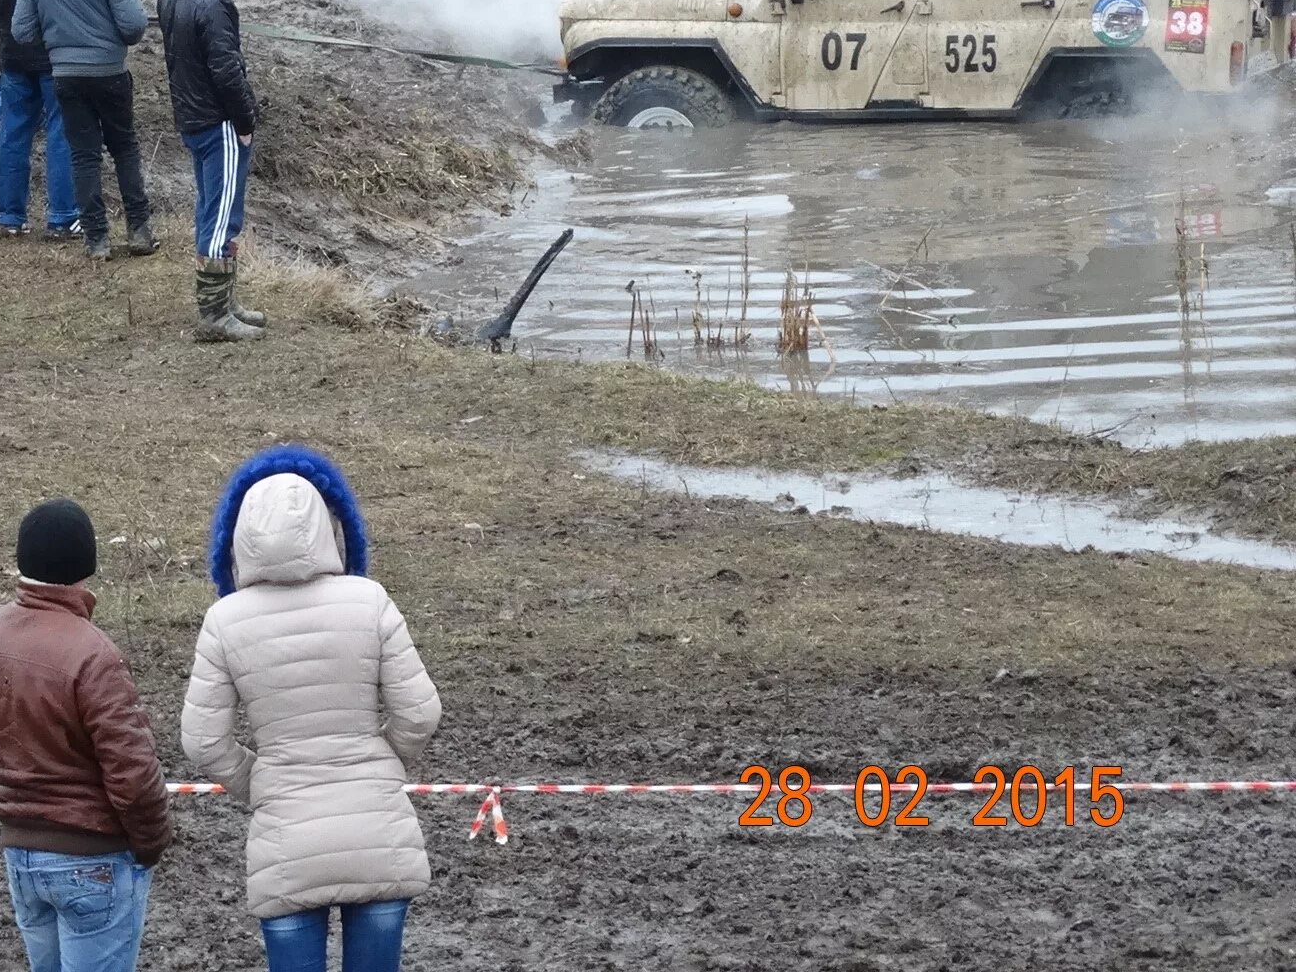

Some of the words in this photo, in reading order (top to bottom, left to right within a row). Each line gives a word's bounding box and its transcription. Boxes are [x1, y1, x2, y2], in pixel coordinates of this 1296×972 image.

[1170, 10, 1204, 36] 38
[821, 32, 867, 71] 07
[945, 34, 997, 73] 525
